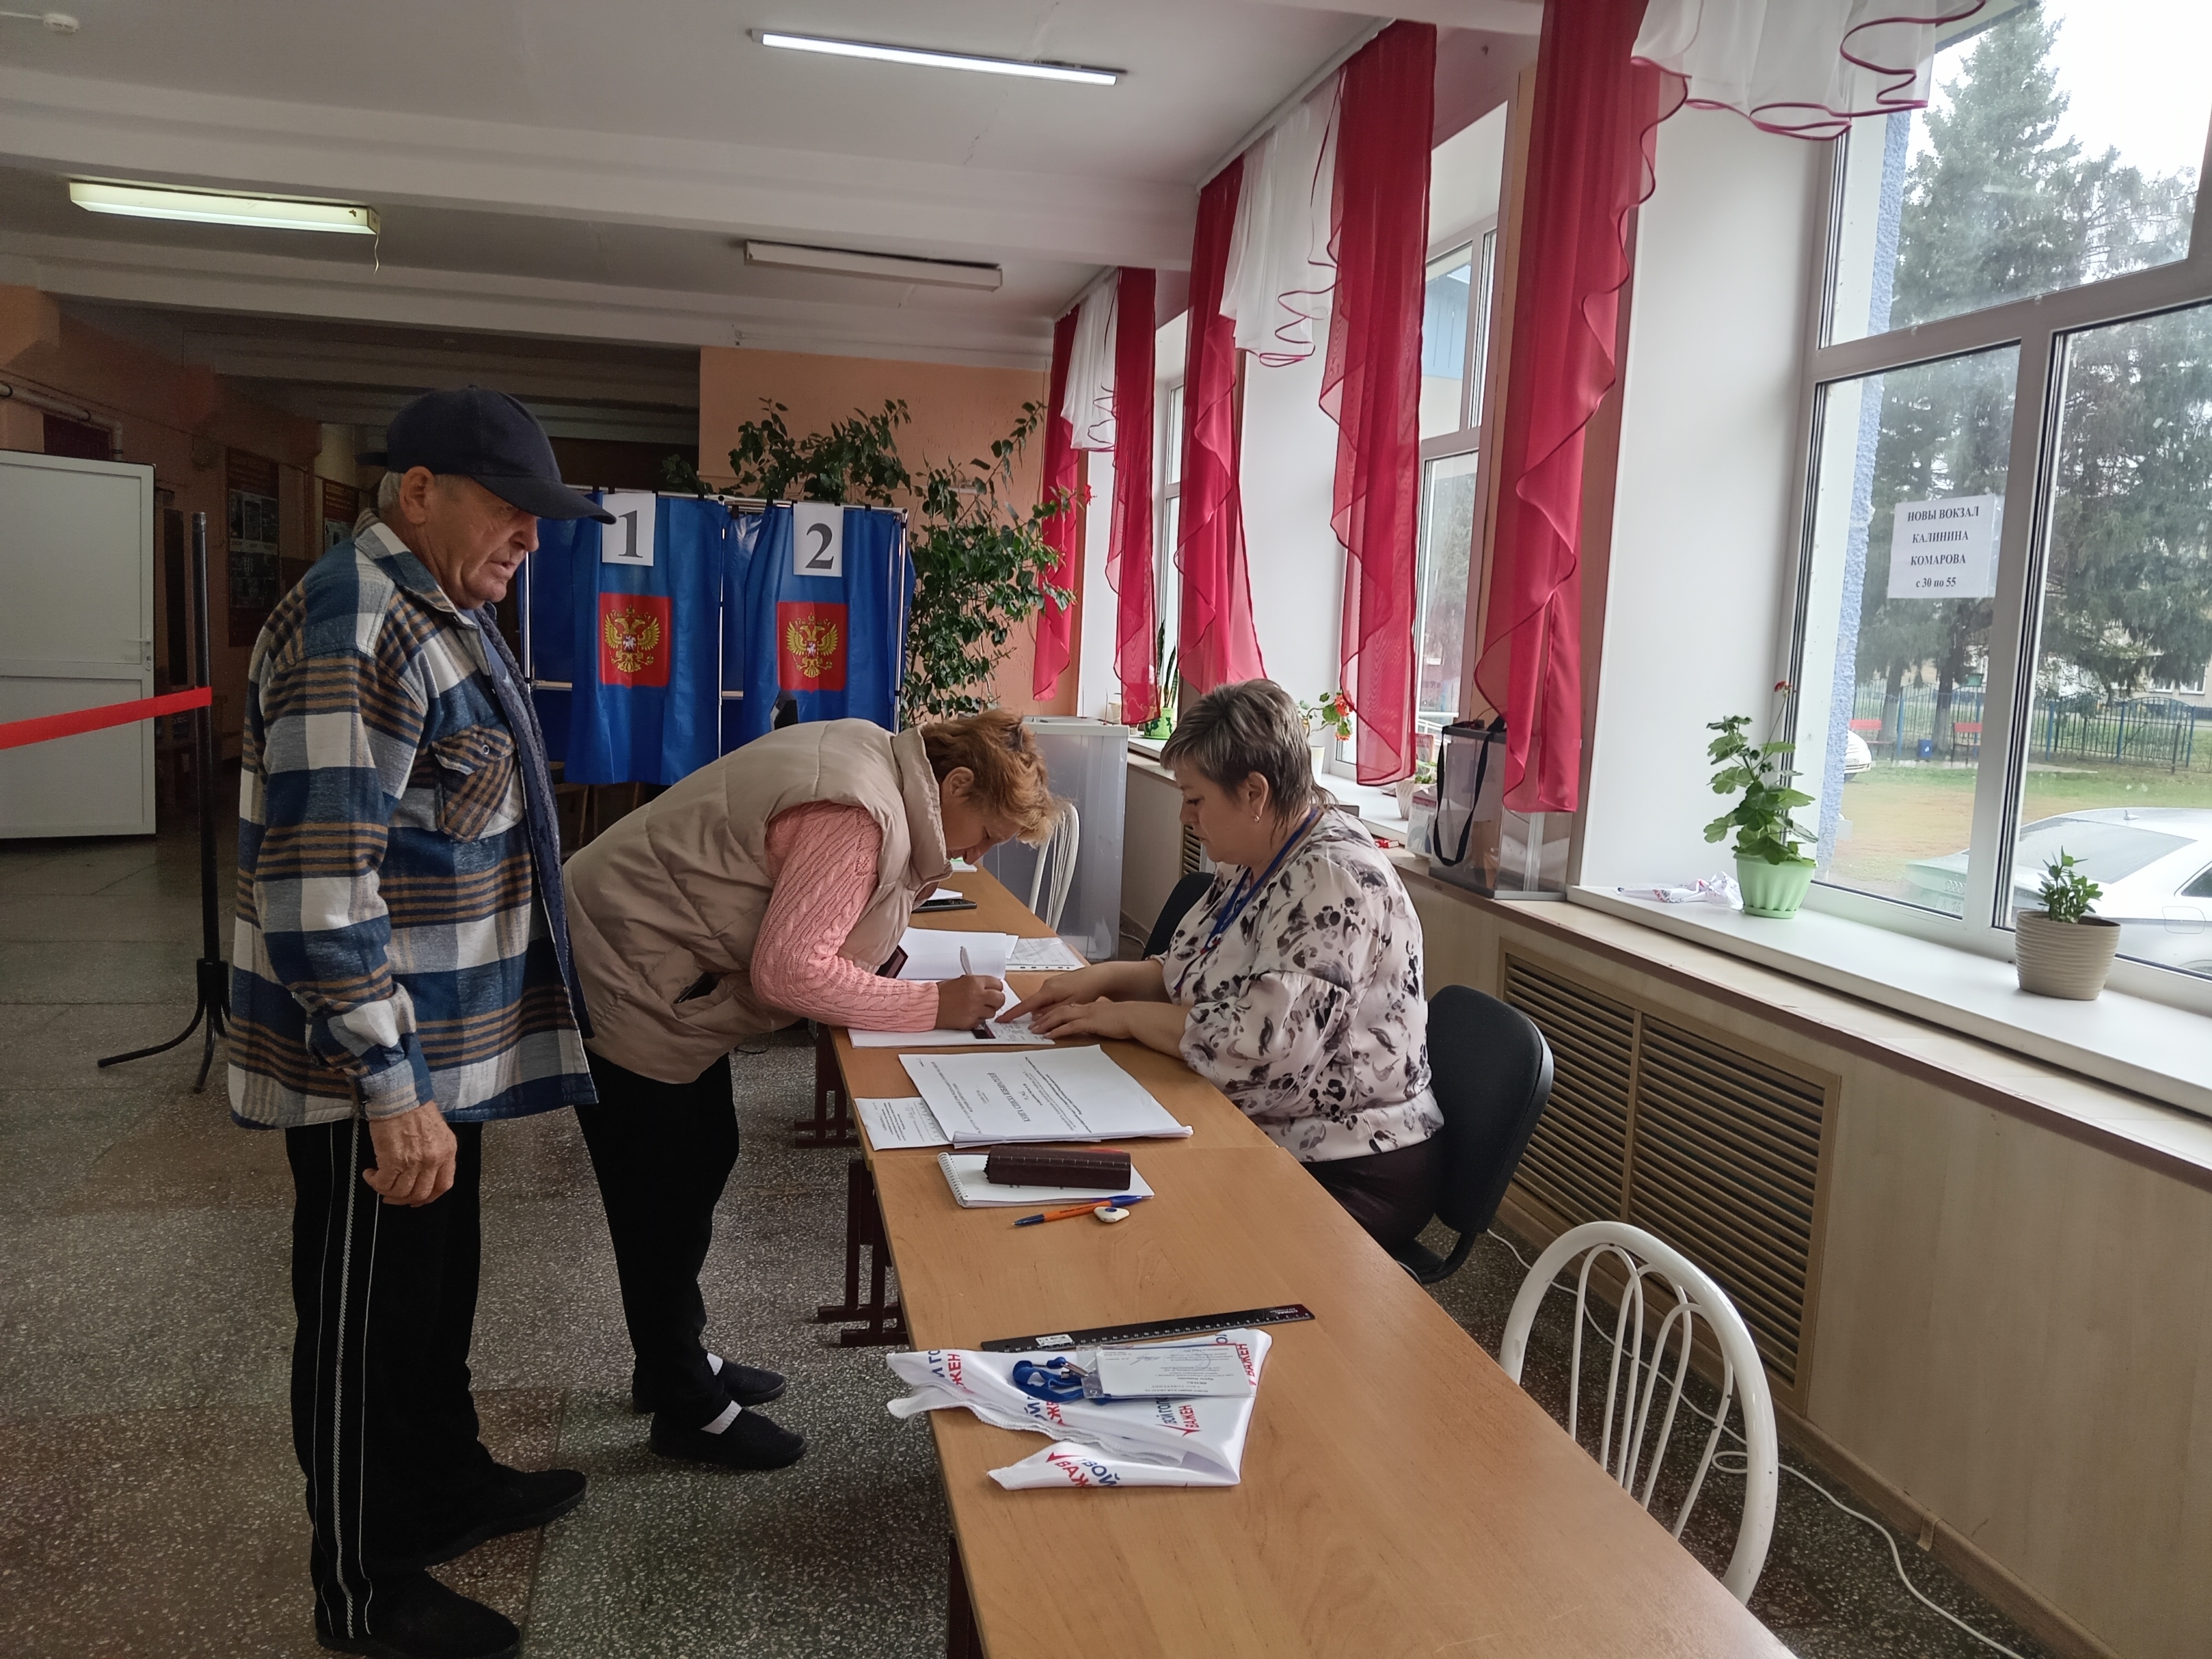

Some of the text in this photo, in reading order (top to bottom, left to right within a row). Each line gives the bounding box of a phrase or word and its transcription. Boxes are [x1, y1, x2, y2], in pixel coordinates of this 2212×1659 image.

[1907, 506, 1979, 522] НОВЫ ВОКЗАЛ
[617, 510, 643, 558] 1
[1912, 530, 1969, 543] КАЛИНИНА
[805, 523, 834, 570] 2
[1911, 554, 1966, 565] КОМАРОВА
[1922, 577, 1932, 588] 30
[1946, 577, 1957, 587] 55
[1178, 1405, 1199, 1427] ВАЖЕН
